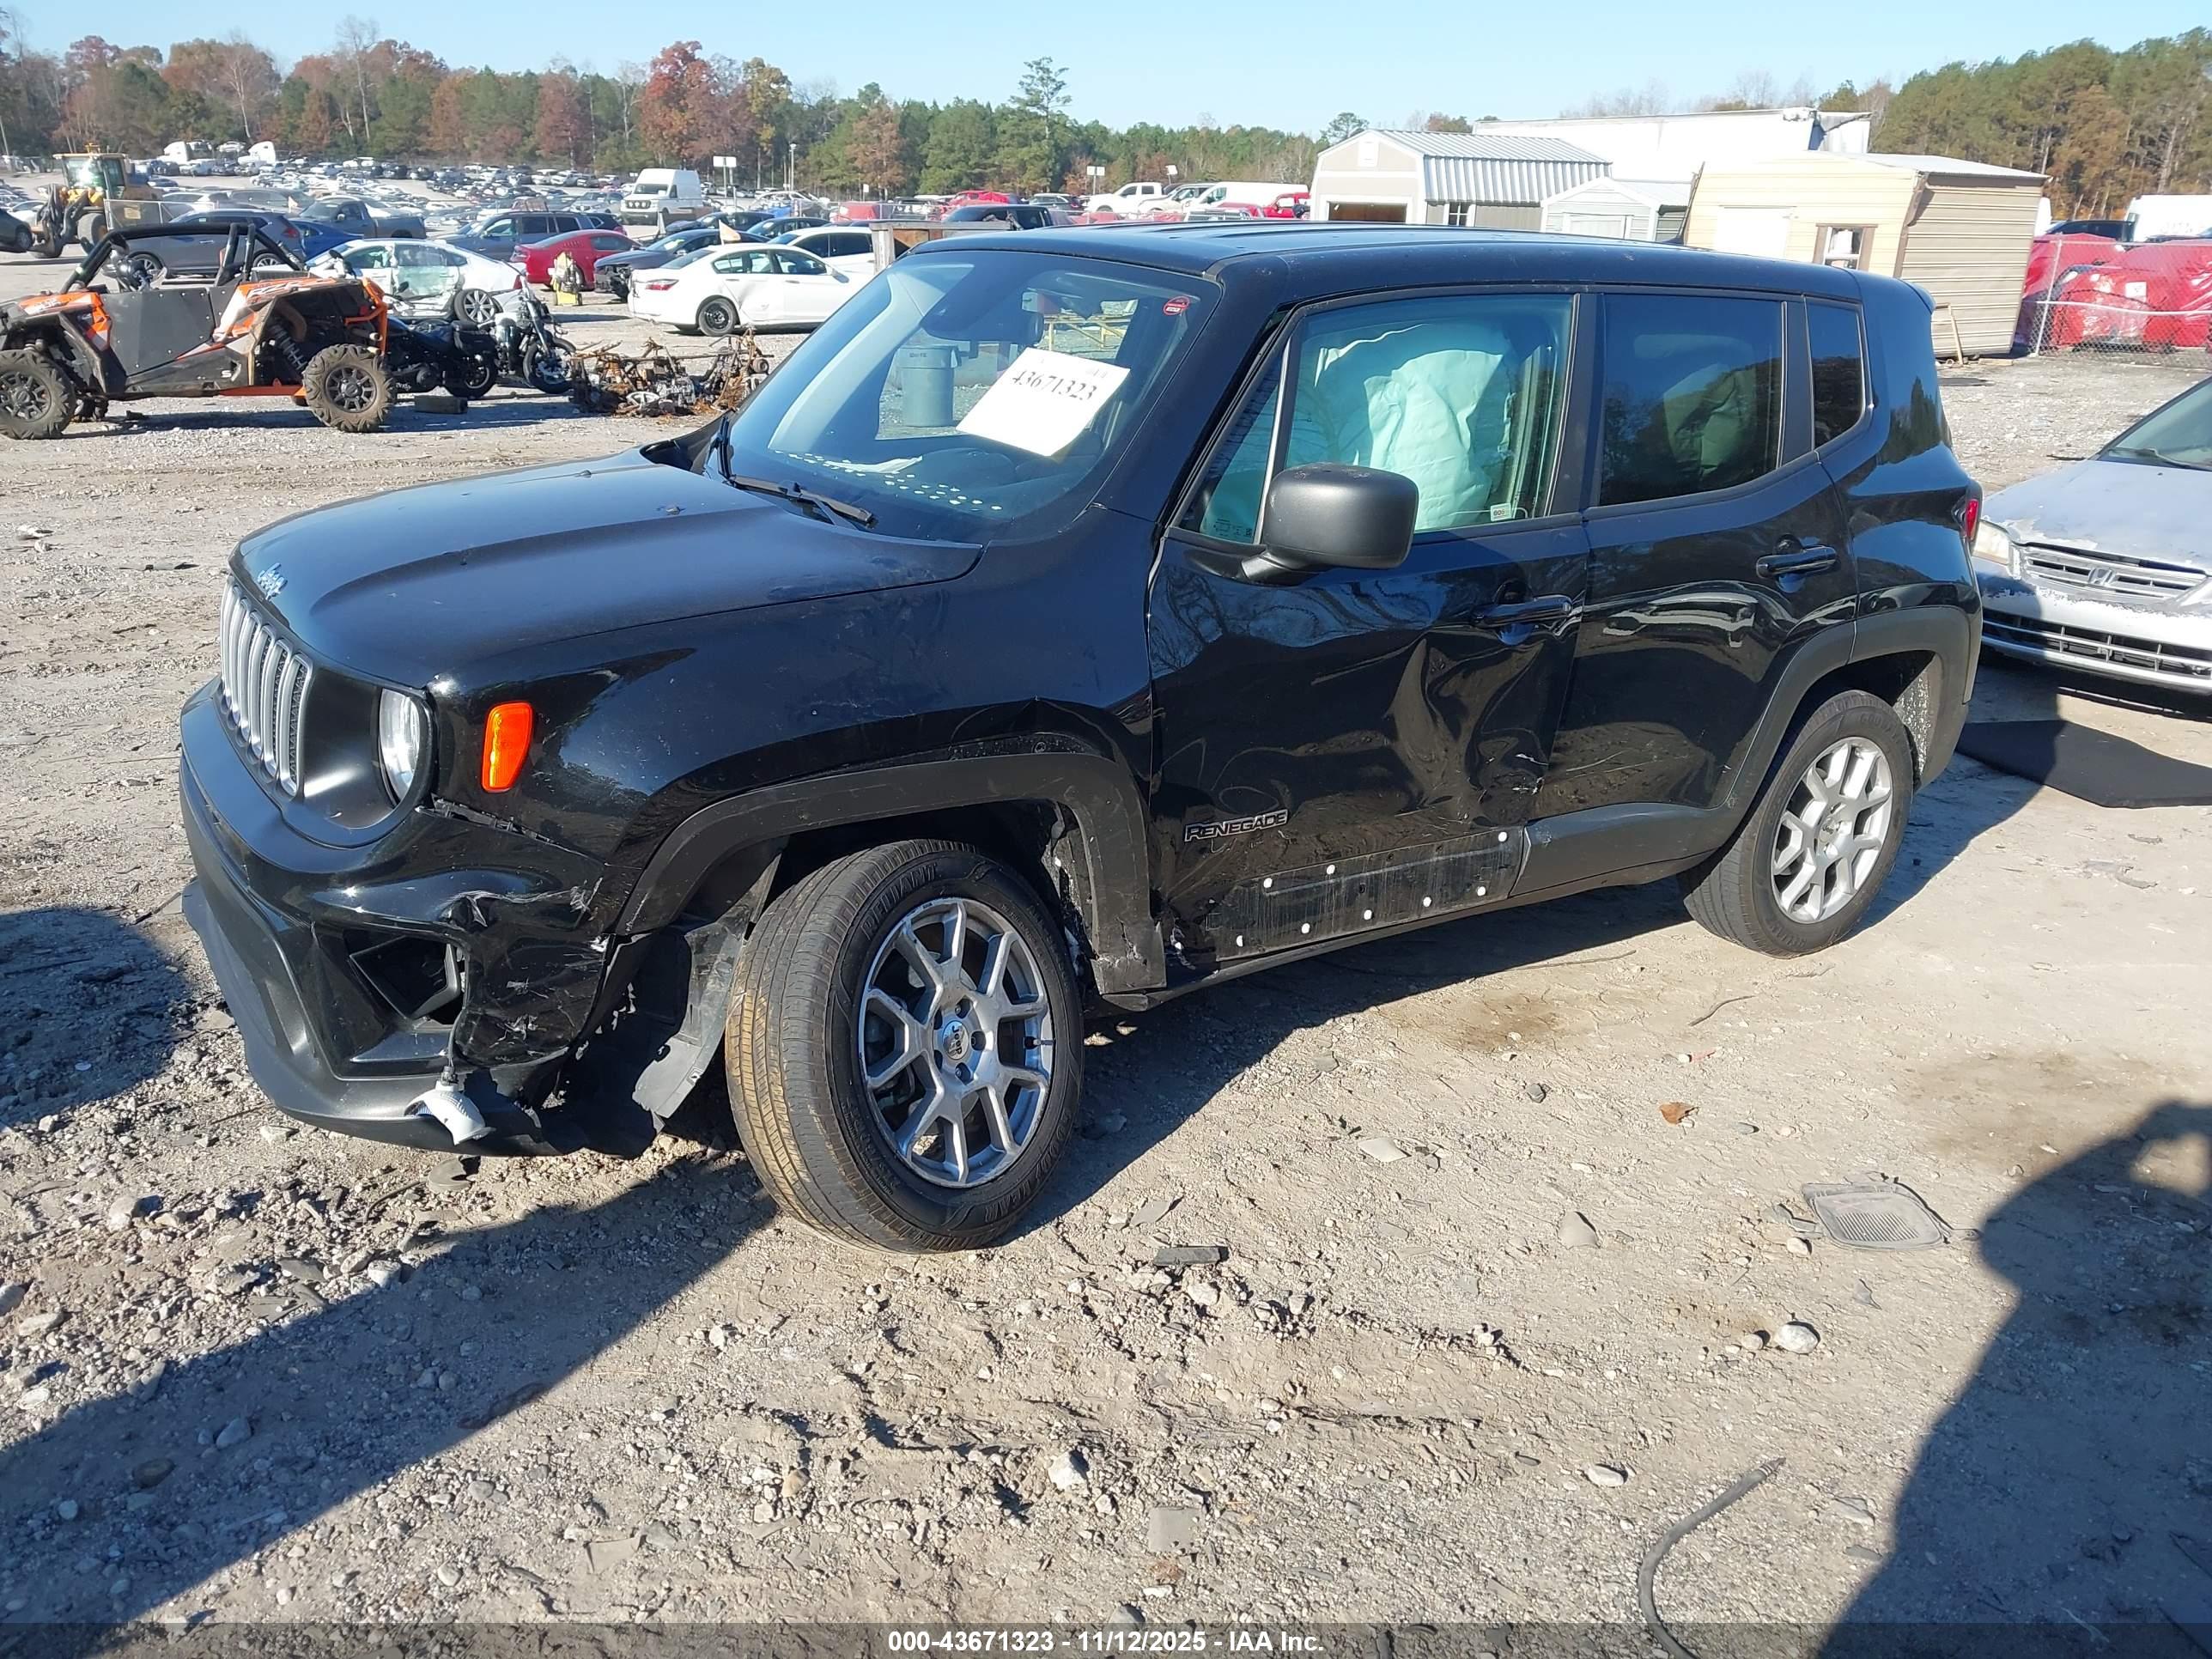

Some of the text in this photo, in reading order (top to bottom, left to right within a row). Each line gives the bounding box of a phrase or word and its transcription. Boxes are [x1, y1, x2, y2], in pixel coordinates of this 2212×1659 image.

[1012, 369, 1098, 400] 43671323
[1184, 809, 1288, 842] RENEGADE
[860, 862, 938, 941] RELIANT
[951, 1024, 963, 1054] Jeep
